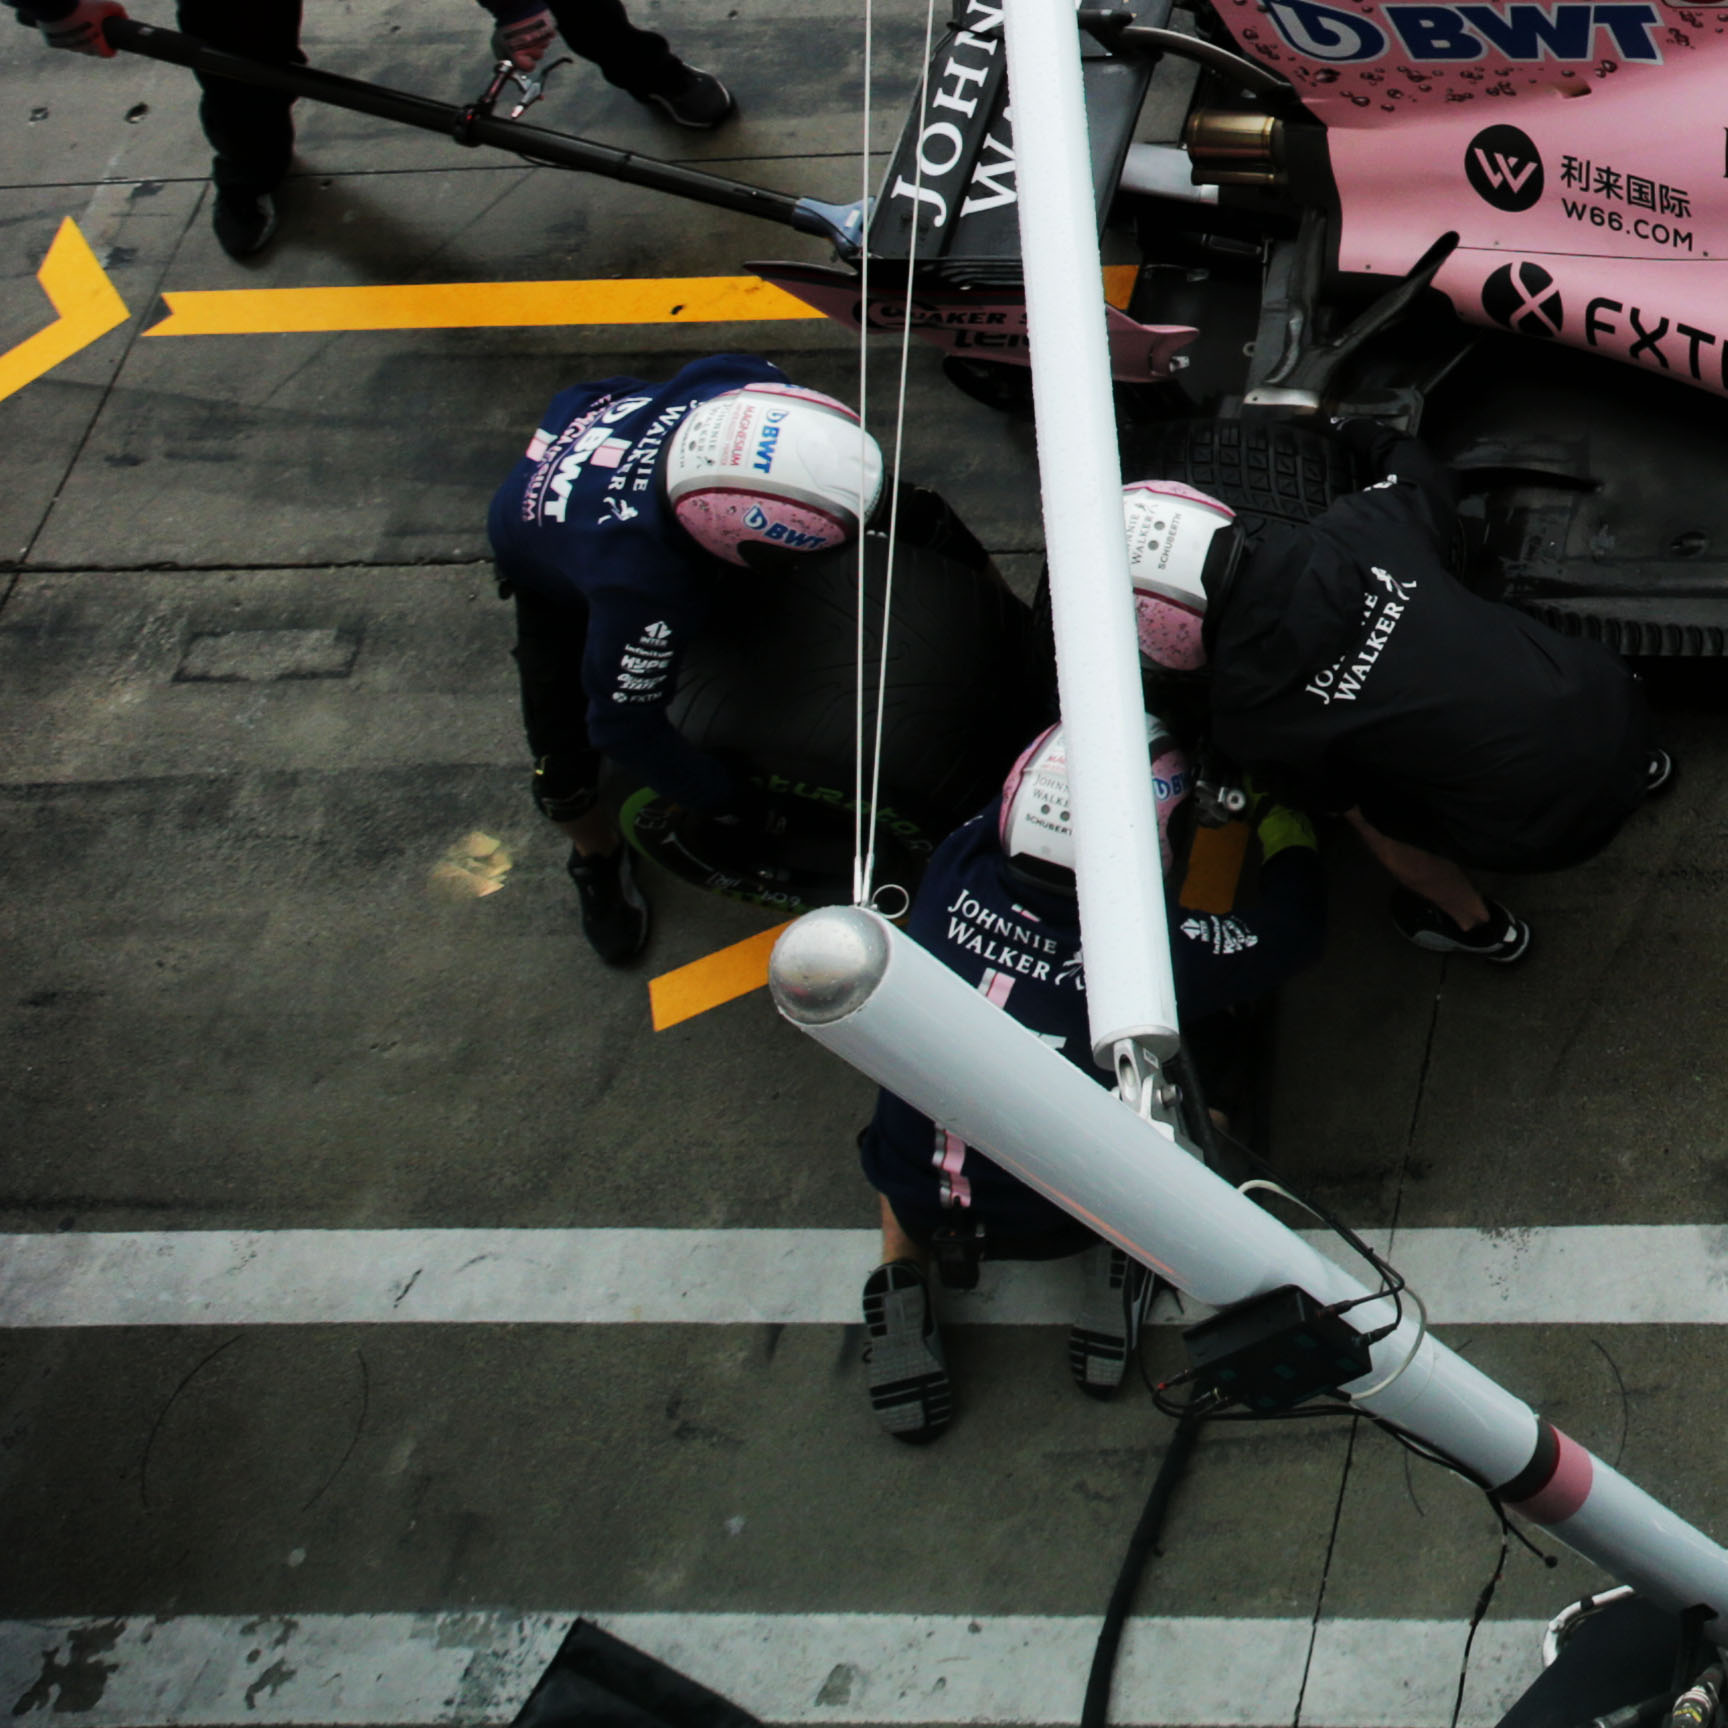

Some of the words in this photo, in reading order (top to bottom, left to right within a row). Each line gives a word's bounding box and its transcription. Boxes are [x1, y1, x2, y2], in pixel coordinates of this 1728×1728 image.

[1387, 2, 1666, 65] BWT
[1561, 154, 1693, 219] 利来国际
[1562, 200, 1694, 253] W66.COM
[544, 426, 613, 522] BWT
[753, 427, 780, 474] BWT
[764, 523, 826, 549] BWT
[1334, 601, 1406, 702] WALKER
[948, 890, 1057, 955] JOHNNIE
[948, 918, 1051, 981] WALKER
